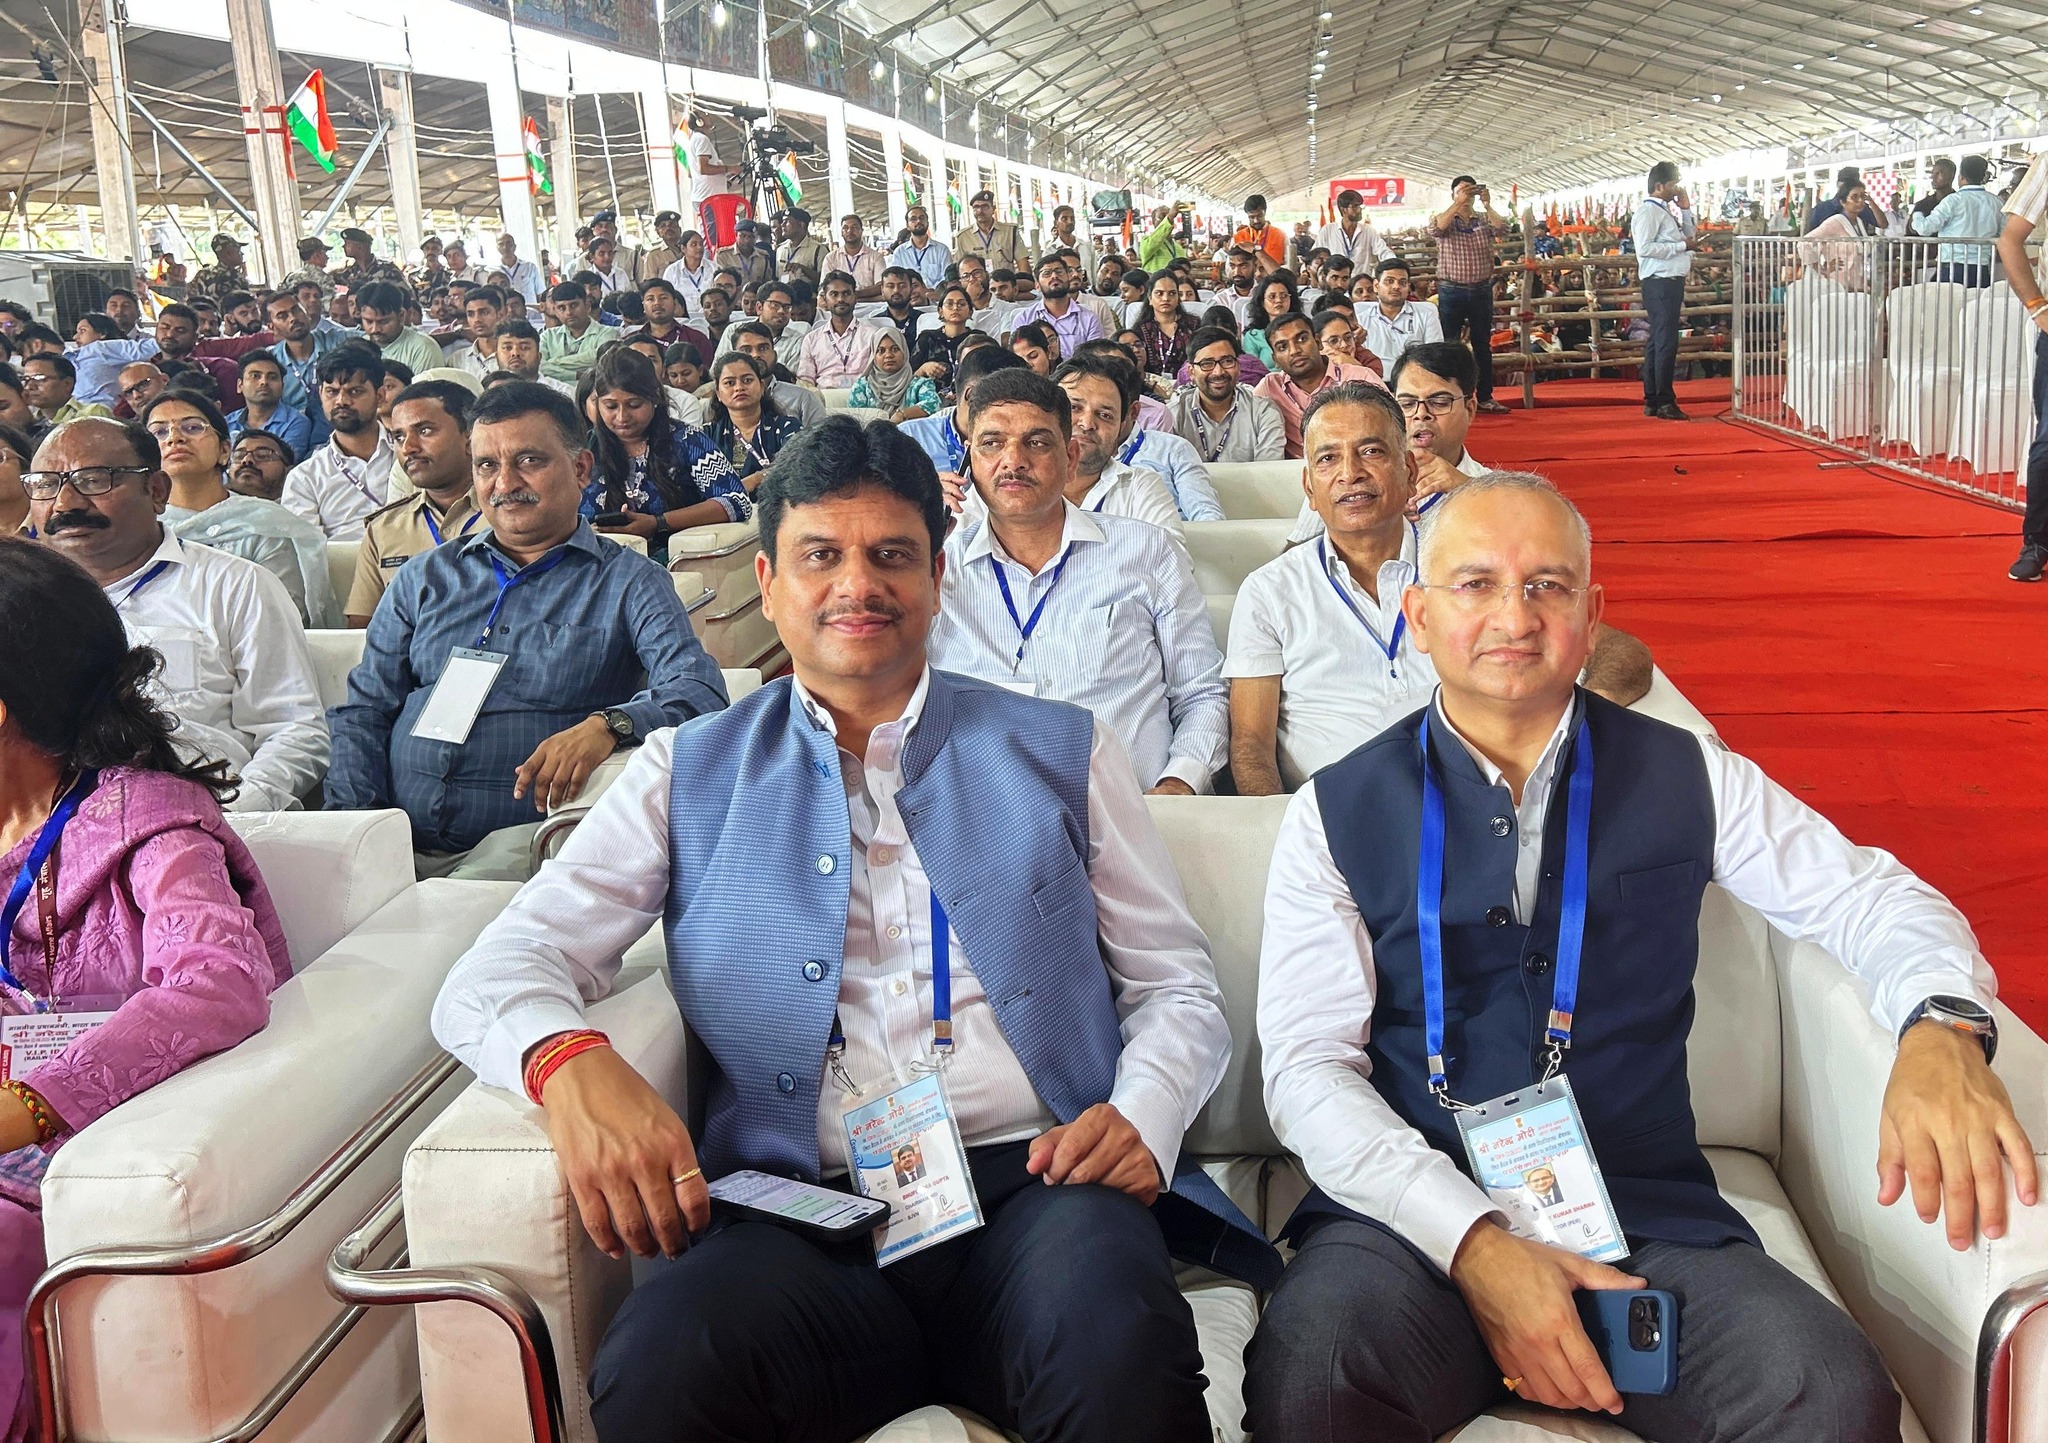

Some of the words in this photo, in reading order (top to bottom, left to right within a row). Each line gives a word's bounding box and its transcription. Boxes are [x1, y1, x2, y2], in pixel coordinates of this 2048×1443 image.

[39, 862, 48, 884] मंत्राल
[45, 915, 54, 936] Affairs
[852, 1124, 863, 1137] श्री
[887, 1104, 906, 1120] मोदी
[1479, 1142, 1490, 1155] श्री
[1515, 1126, 1536, 1142] मोदी
[931, 1175, 950, 1187] GUPTA
[1552, 1208, 1573, 1219] KUMAR
[1572, 1201, 1596, 1212] SHARMA
